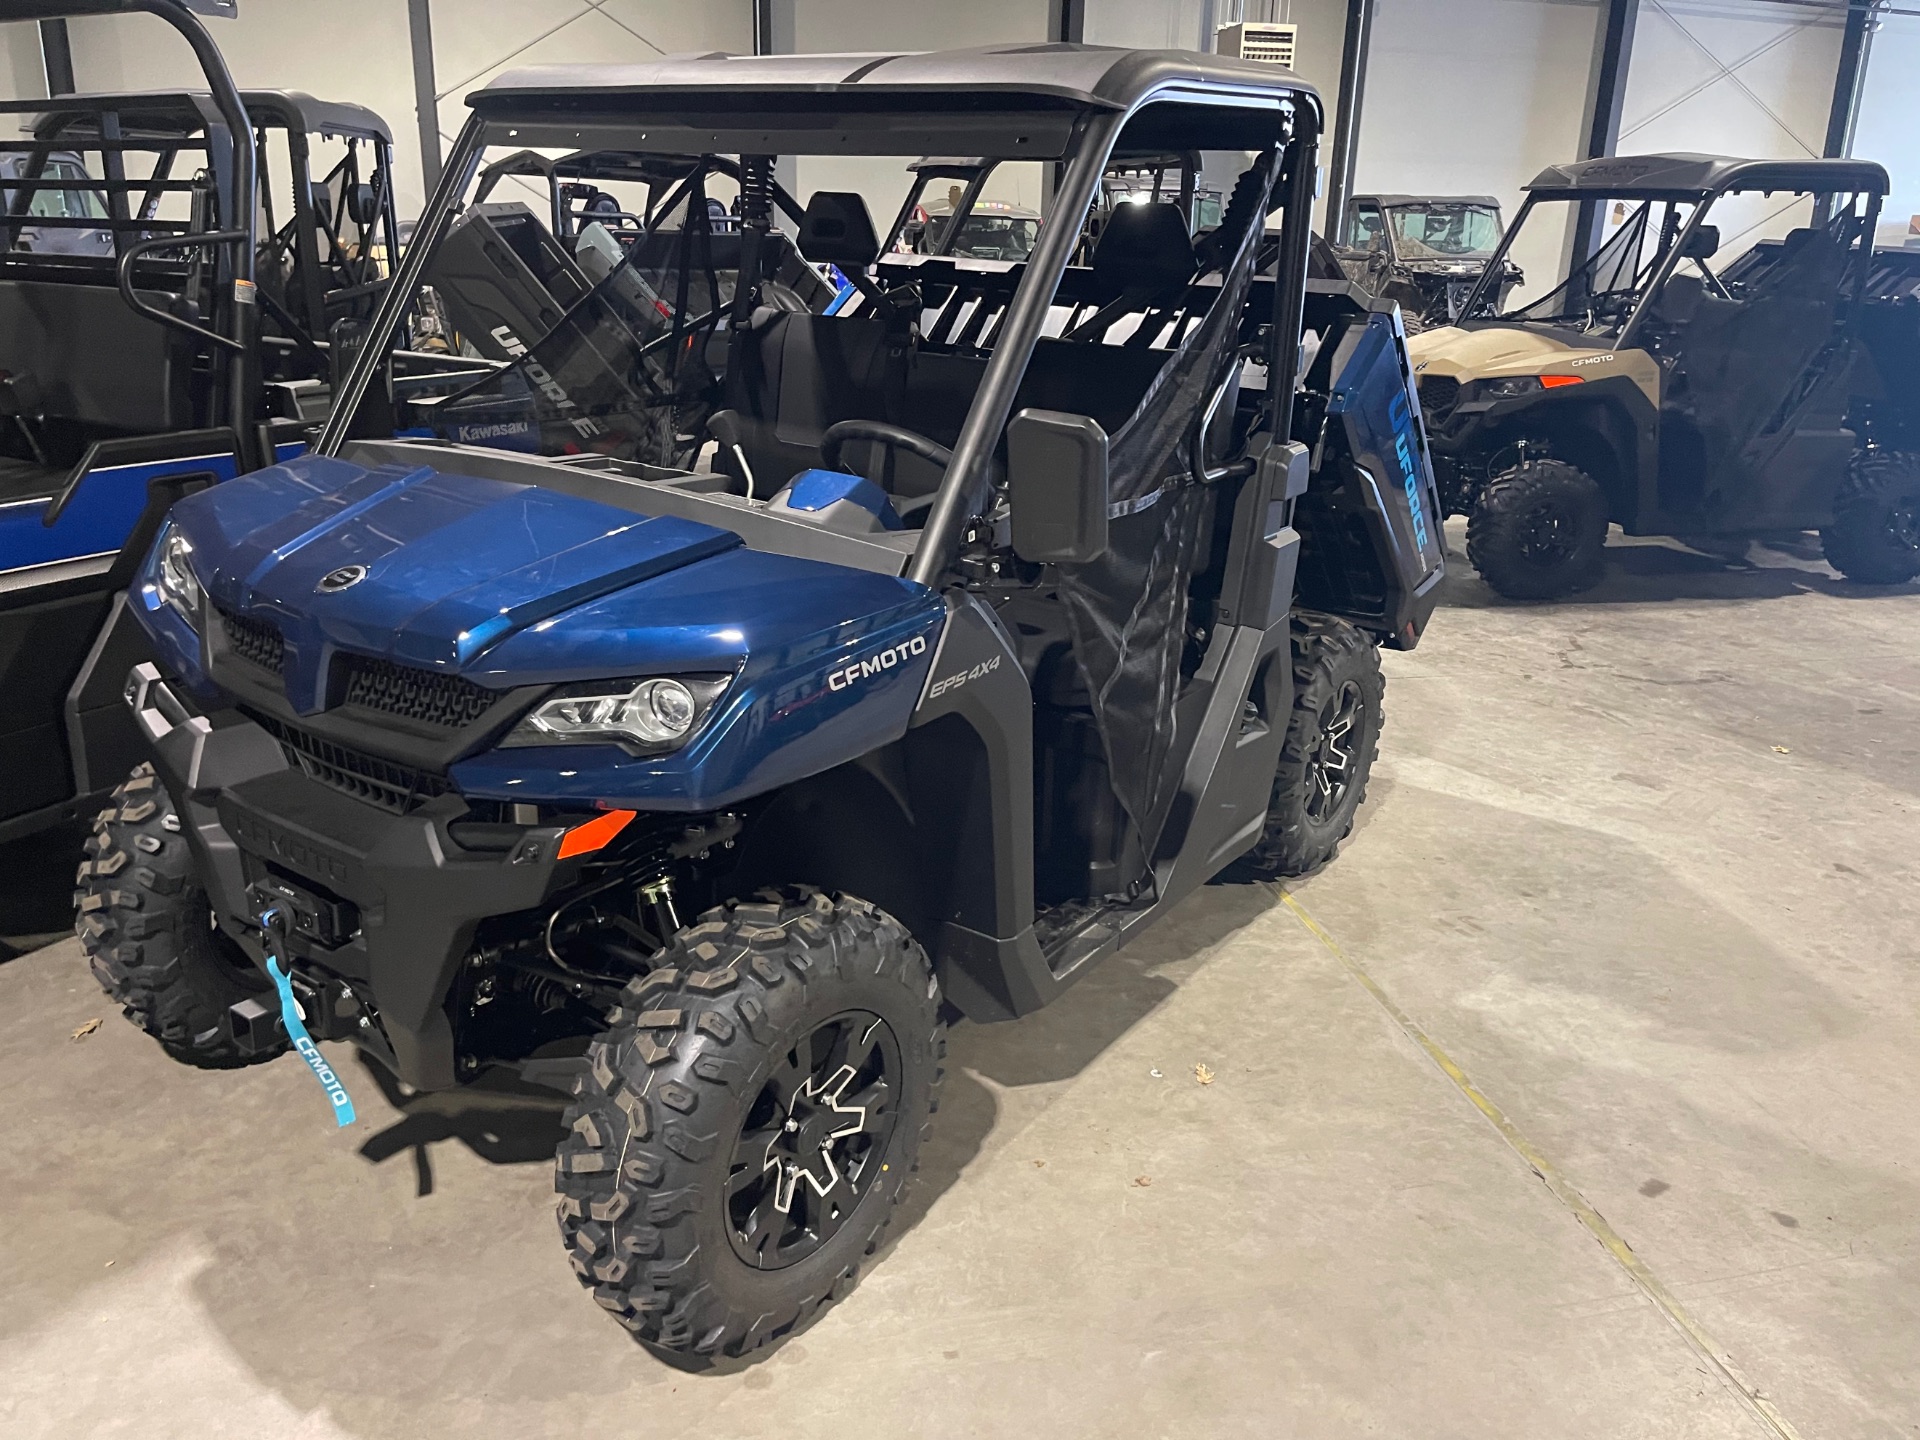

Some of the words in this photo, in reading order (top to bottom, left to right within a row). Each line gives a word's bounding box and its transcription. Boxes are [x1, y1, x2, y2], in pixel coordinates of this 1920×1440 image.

[1571, 354, 1614, 367] CFMOTO
[458, 421, 529, 442] Kawasaki
[1395, 432, 1428, 553] UFORCE
[827, 635, 927, 692] CFMOTO
[928, 670, 968, 699] EPS
[967, 654, 1001, 680] 4X4
[295, 1036, 348, 1107] CFMOTO
